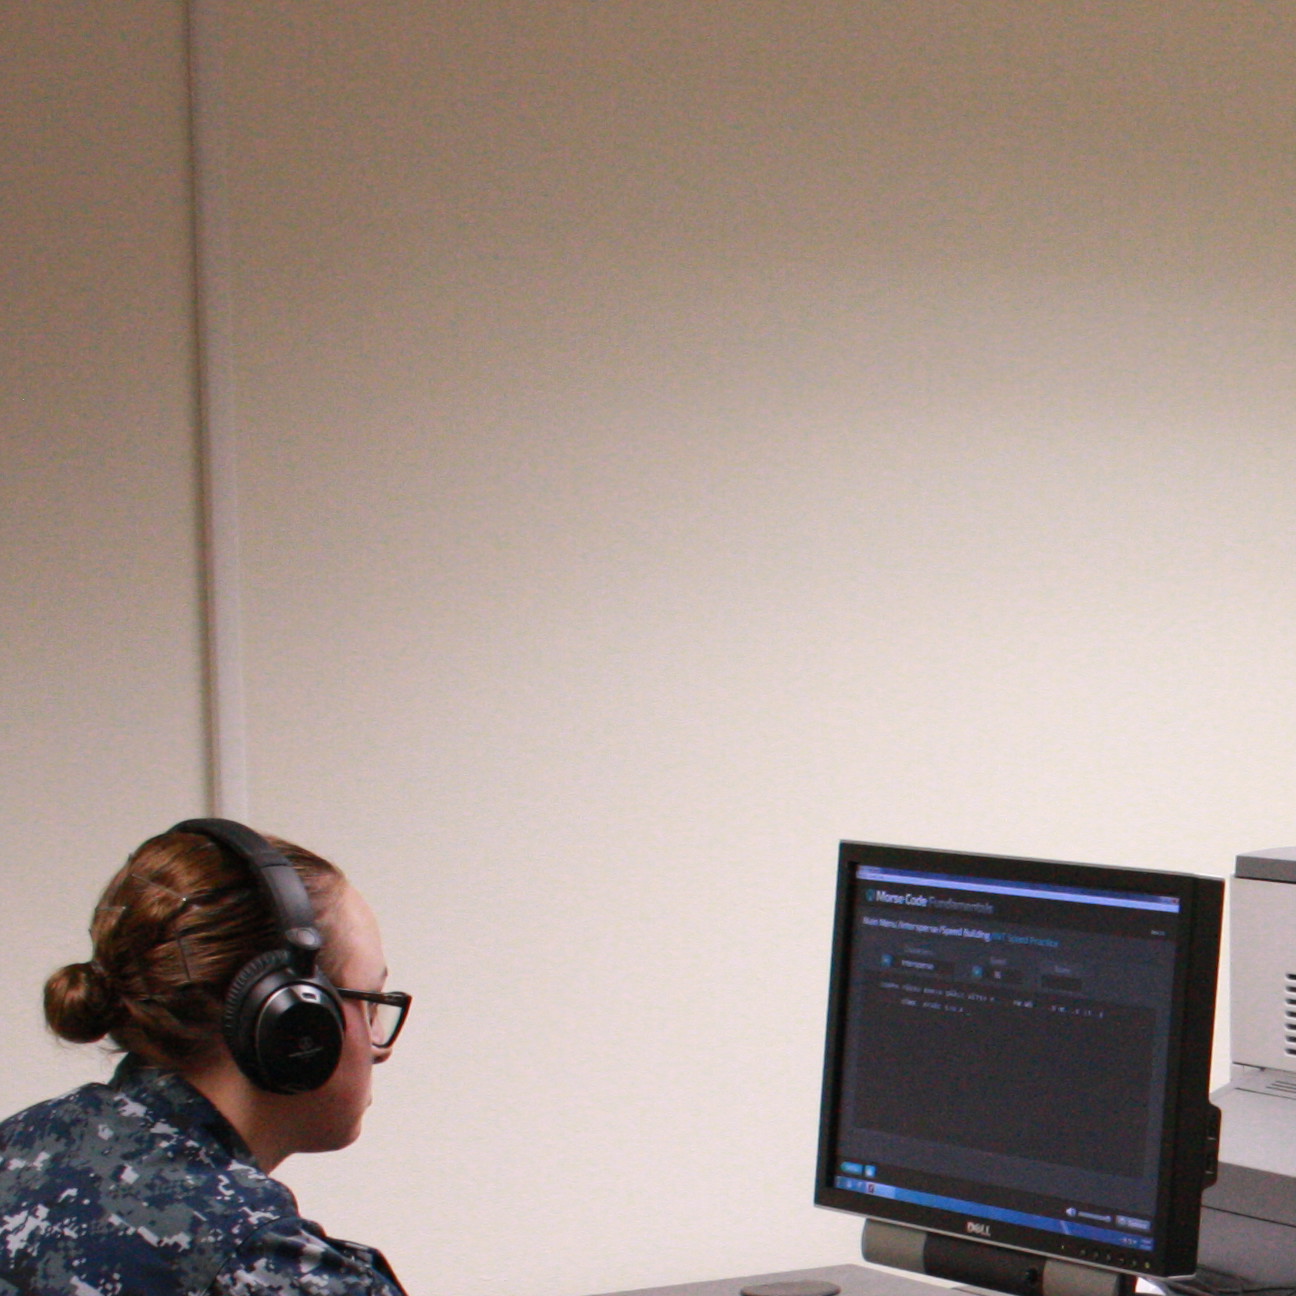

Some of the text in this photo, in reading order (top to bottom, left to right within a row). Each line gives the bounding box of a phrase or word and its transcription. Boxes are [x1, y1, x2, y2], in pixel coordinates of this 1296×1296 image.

[876, 890, 905, 905] Morse
[905, 893, 928, 908] Code
[965, 1220, 992, 1238] DELL
